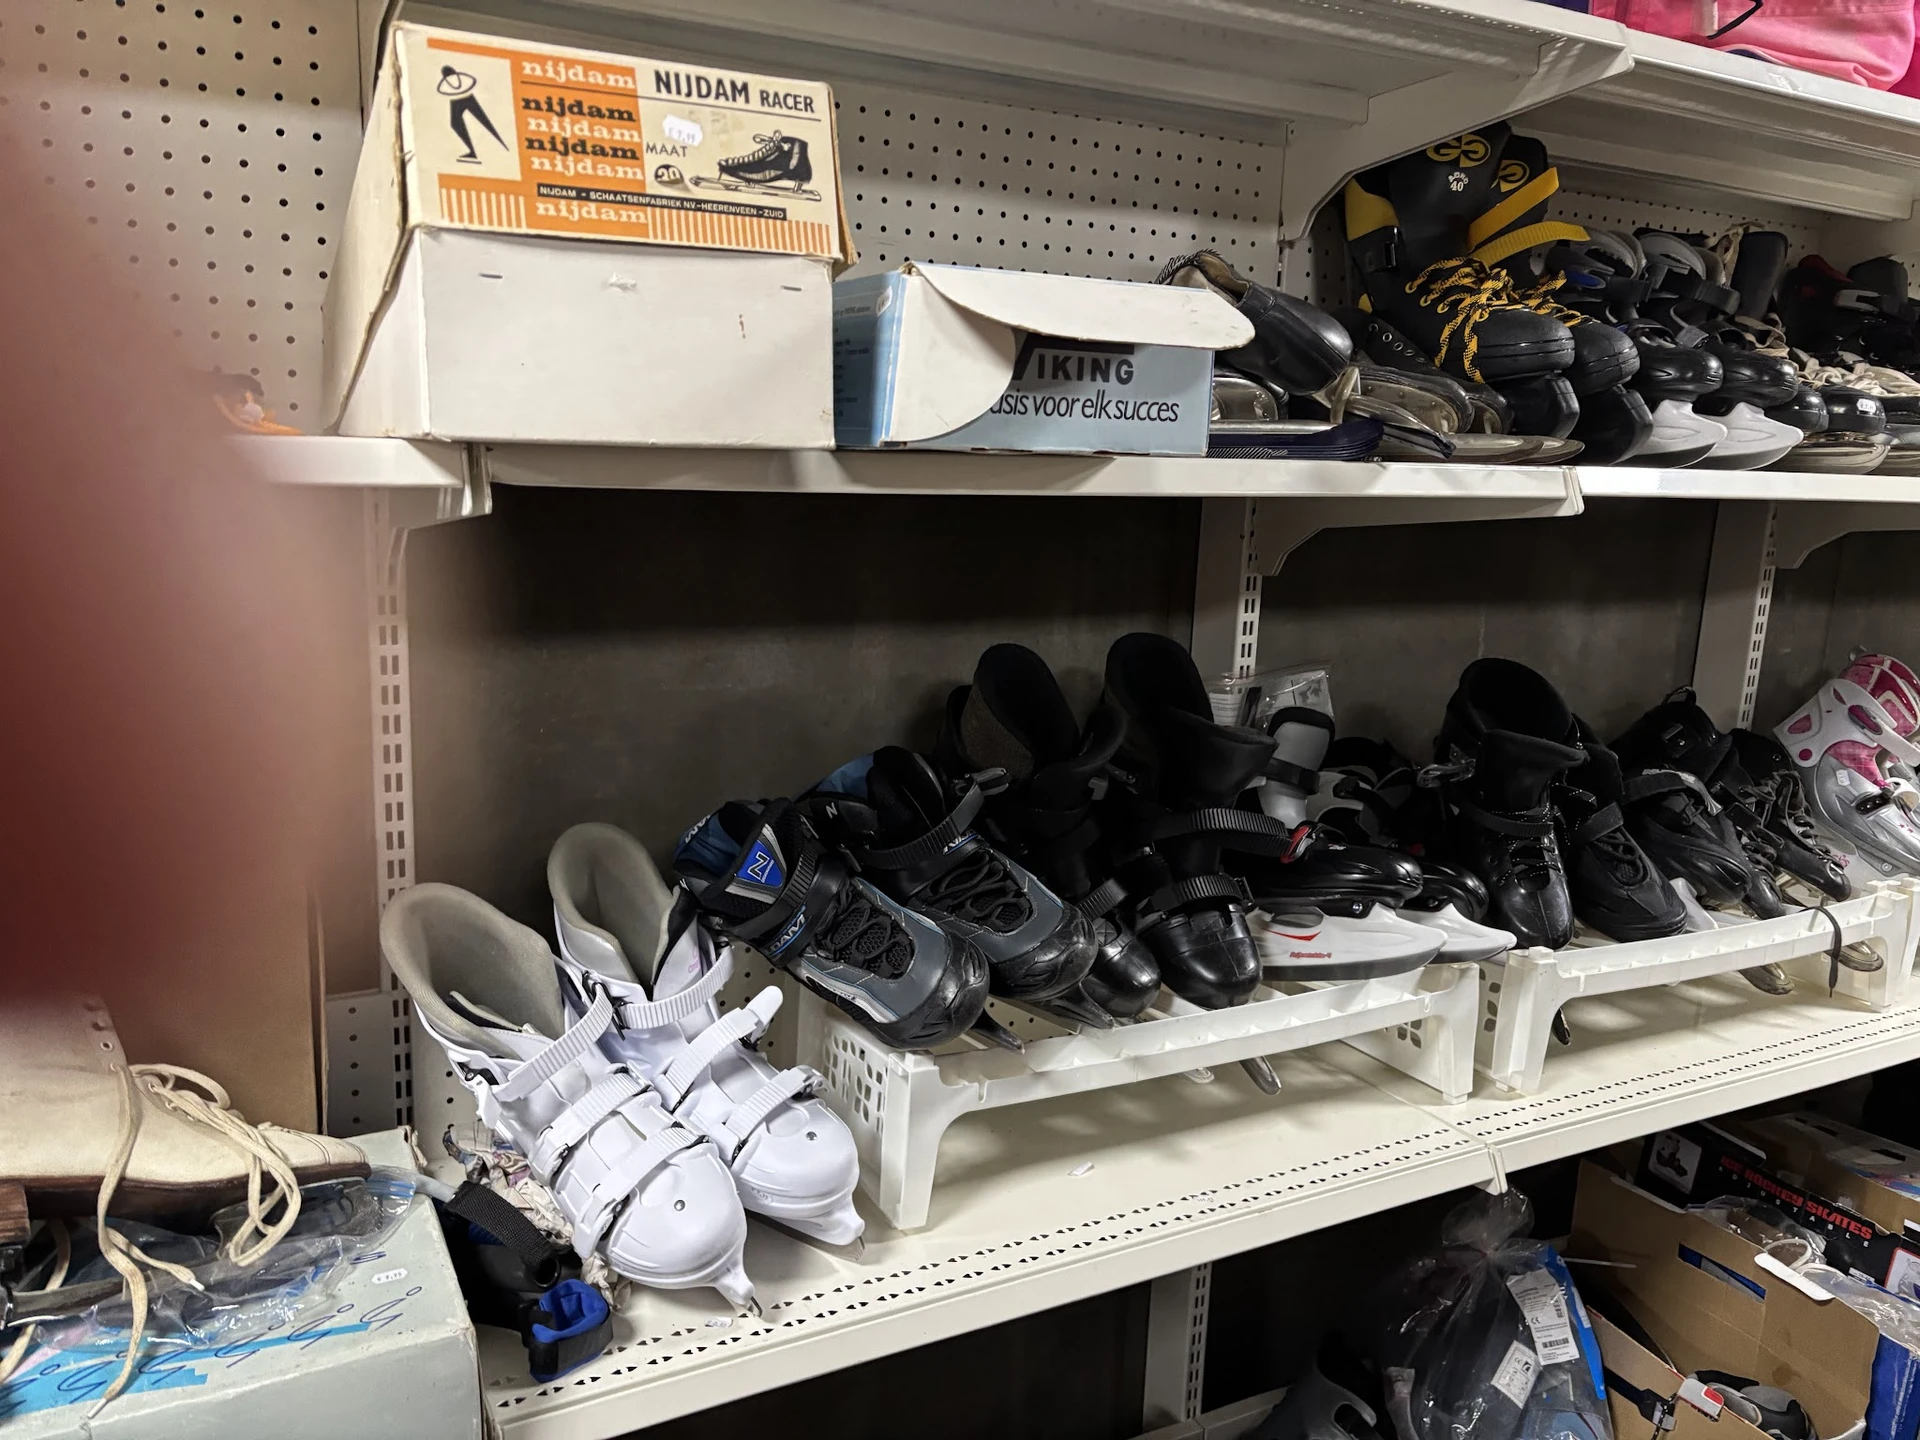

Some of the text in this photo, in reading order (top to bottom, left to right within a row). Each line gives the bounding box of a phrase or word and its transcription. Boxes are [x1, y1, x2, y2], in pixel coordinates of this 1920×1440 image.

[522, 60, 635, 89] nijdam
[654, 69, 815, 114] NIJDAM RACER
[521, 96, 636, 122] nijdam
[527, 116, 641, 142] nijdam
[525, 135, 640, 160] nijdam
[645, 142, 688, 158] MAAT
[531, 155, 644, 180] nijdam
[540, 186, 577, 198] NIJDAM
[589, 191, 682, 208] SCHAATSENFABRIEK
[1450, 181, 1463, 191] 40
[535, 200, 648, 223] nijdam
[989, 388, 1180, 422] asis voor elk succes
[748, 851, 769, 880] N
[1744, 1168, 1804, 1207] HOCKEY
[1805, 1200, 1873, 1240] SKATES
